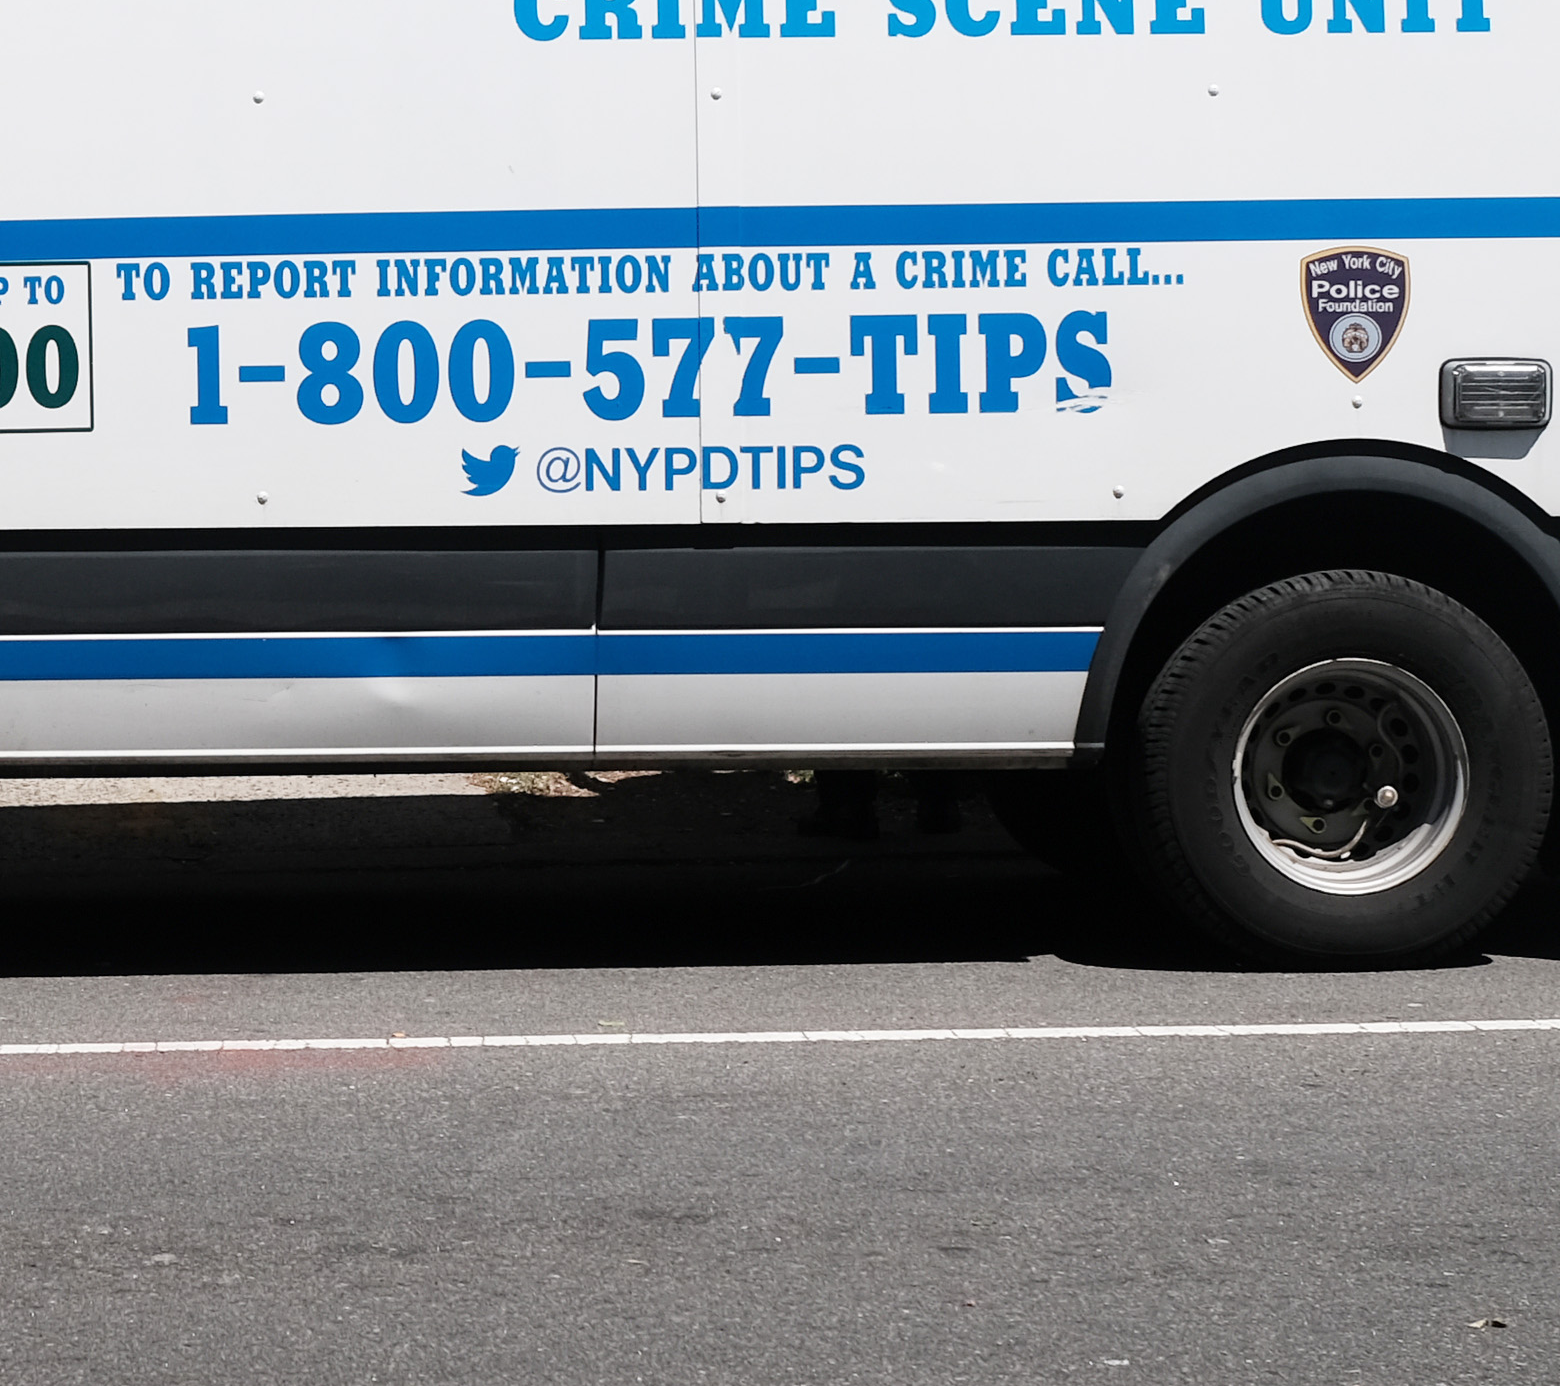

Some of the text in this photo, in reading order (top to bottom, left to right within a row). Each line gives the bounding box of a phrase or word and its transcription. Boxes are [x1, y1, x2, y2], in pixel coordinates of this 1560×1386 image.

[116, 248, 1184, 300] TO REPORT INFORMATION ABOUT A CRIME CALL...
[1308, 254, 1402, 279] New York City
[24, 275, 65, 305] TO
[1311, 280, 1400, 299] Police
[1318, 299, 1394, 313] Foundation
[188, 310, 1112, 425] 1-800-577-TIPS
[537, 444, 865, 493] @NYPDTIPS
